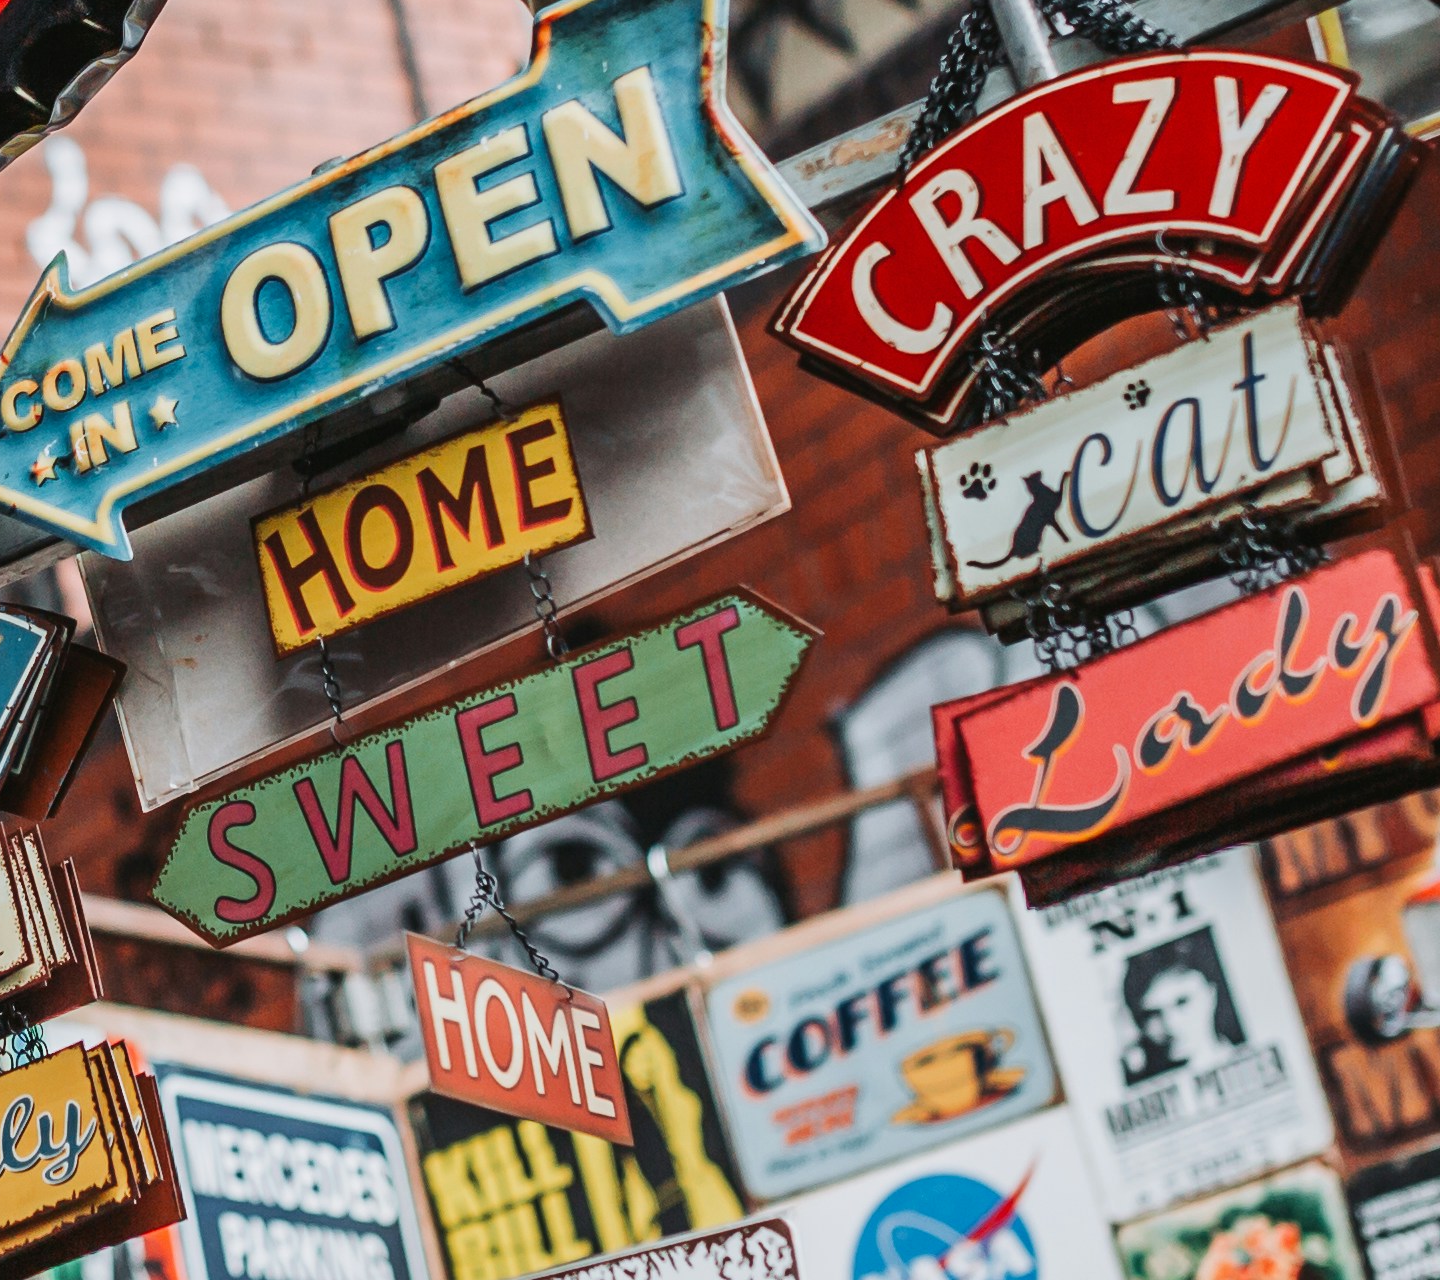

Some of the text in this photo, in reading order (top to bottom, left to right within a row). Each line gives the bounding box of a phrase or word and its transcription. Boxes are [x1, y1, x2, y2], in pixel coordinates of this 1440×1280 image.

[220, 65, 684, 383] OPEN
[851, 75, 1289, 358] CRAZY
[0, 308, 187, 433] COME
[68, 401, 140, 478] IN
[1065, 331, 1304, 539] cat
[263, 418, 576, 637] HOME
[206, 605, 742, 926] SWEET
[422, 960, 617, 1119] HOME
[741, 923, 1003, 1104] COFFEE
[182, 1117, 400, 1227] MERCEDES
[426, 1120, 575, 1220] KILL
